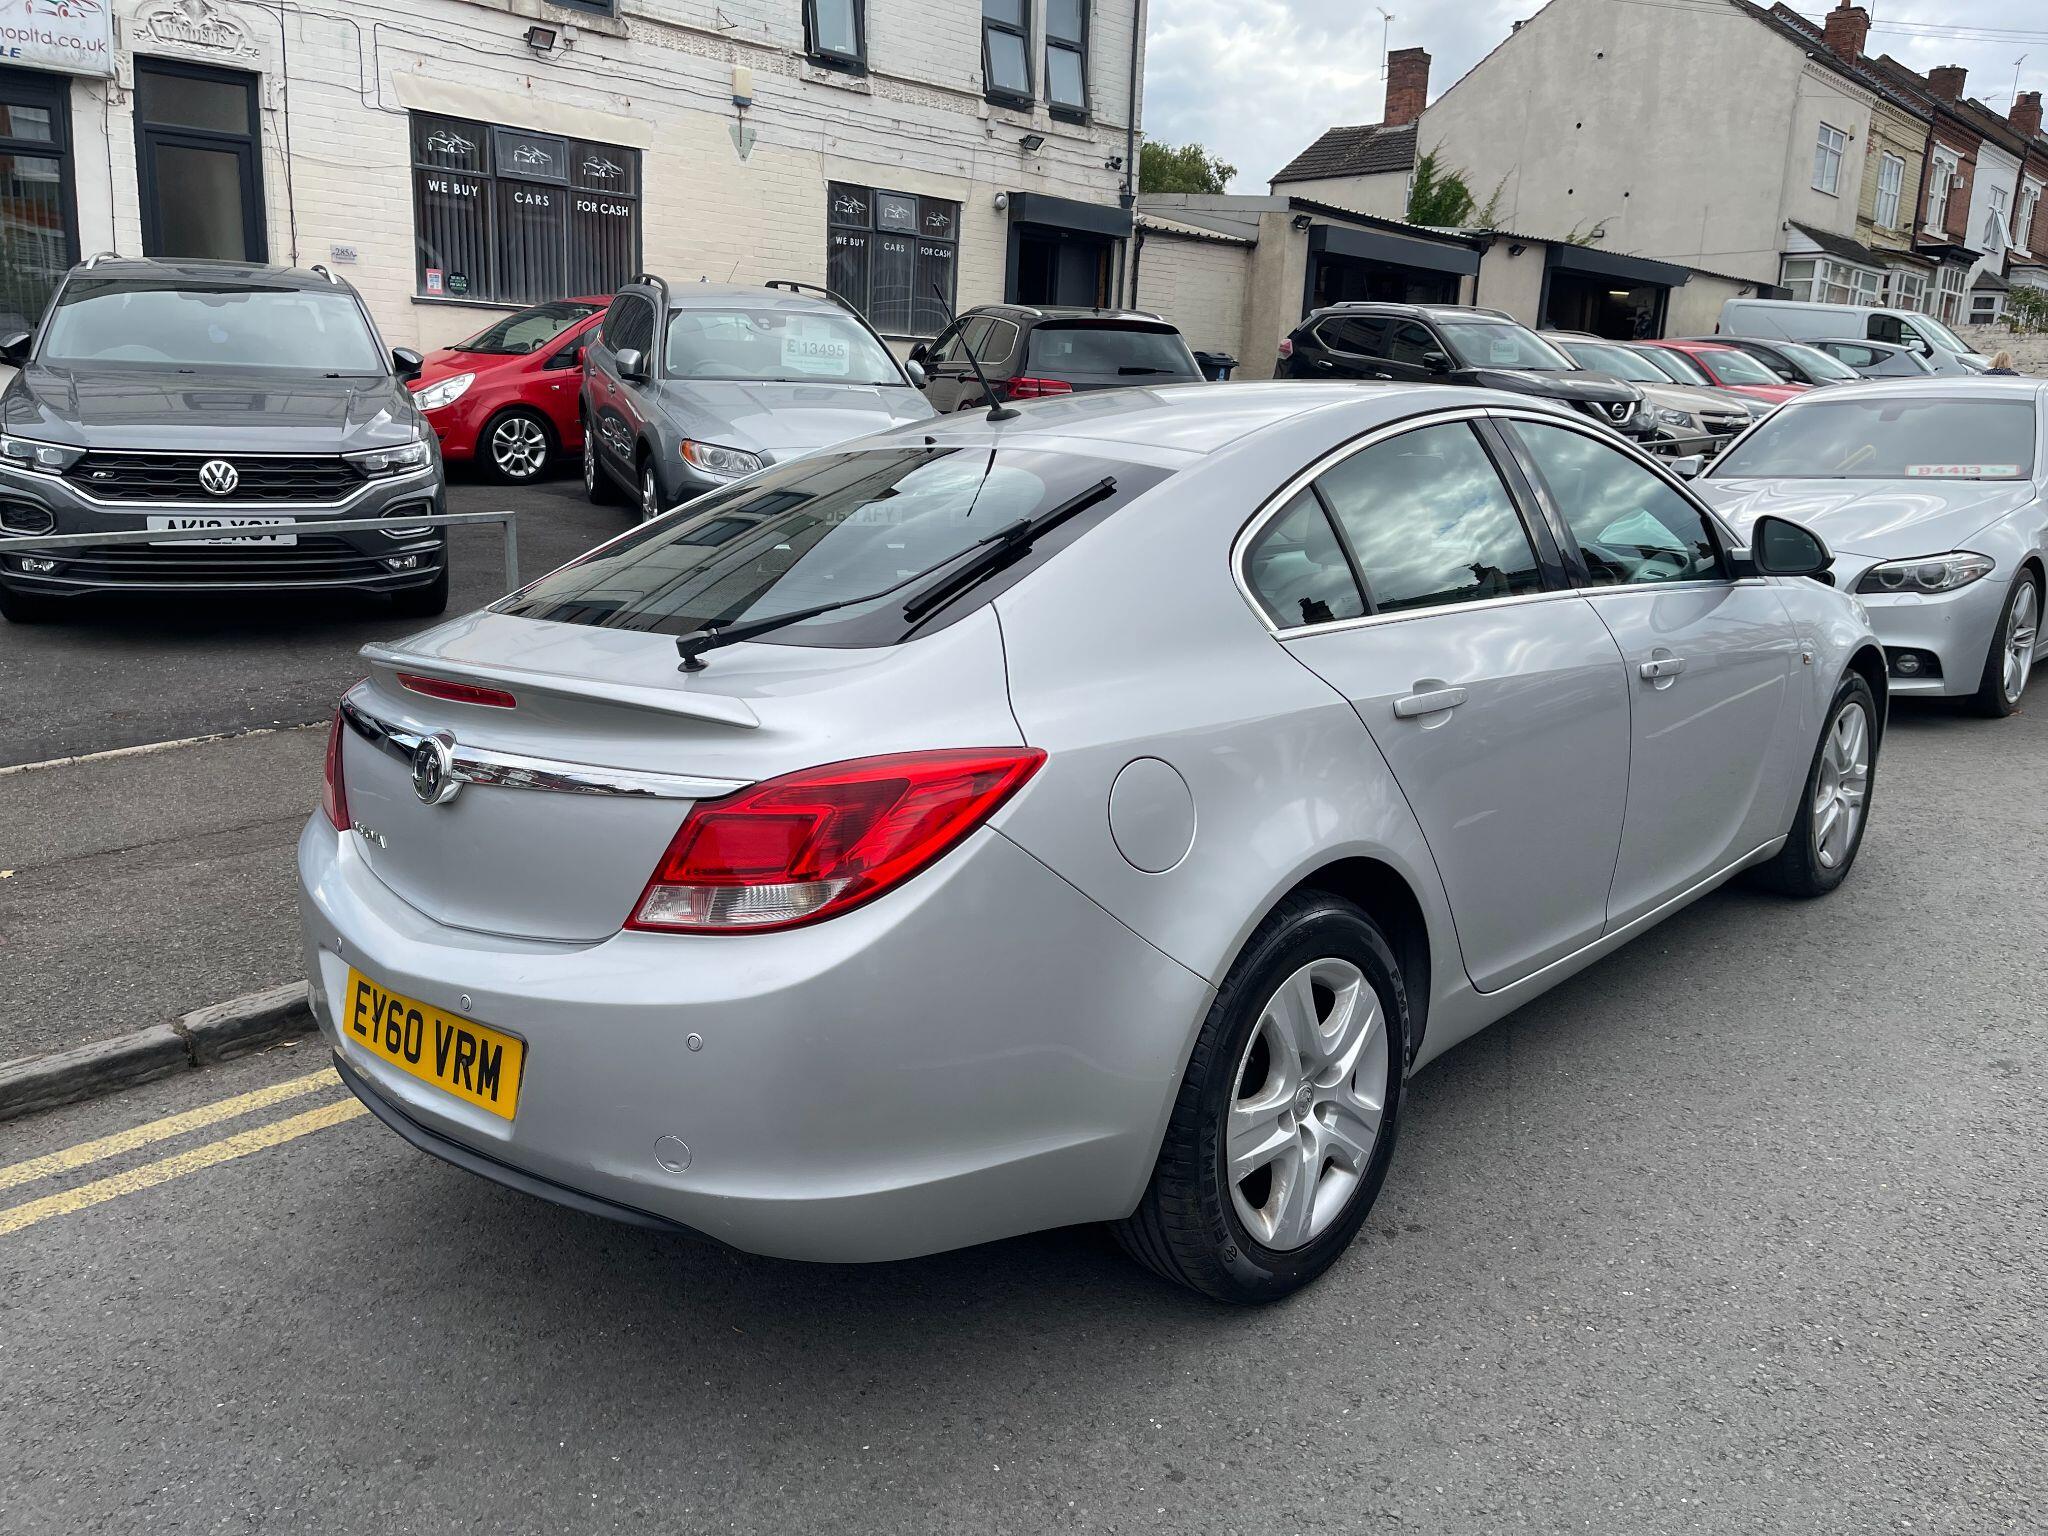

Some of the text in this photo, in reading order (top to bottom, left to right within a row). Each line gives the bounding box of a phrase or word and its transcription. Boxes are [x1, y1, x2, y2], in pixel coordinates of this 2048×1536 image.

[428, 180, 629, 217] WE BUY CARS FOR CASH
[836, 236, 952, 258] WE BUY CARS FOR CASH
[802, 342, 845, 357] 13495
[353, 980, 503, 1102] EY60 VRM
